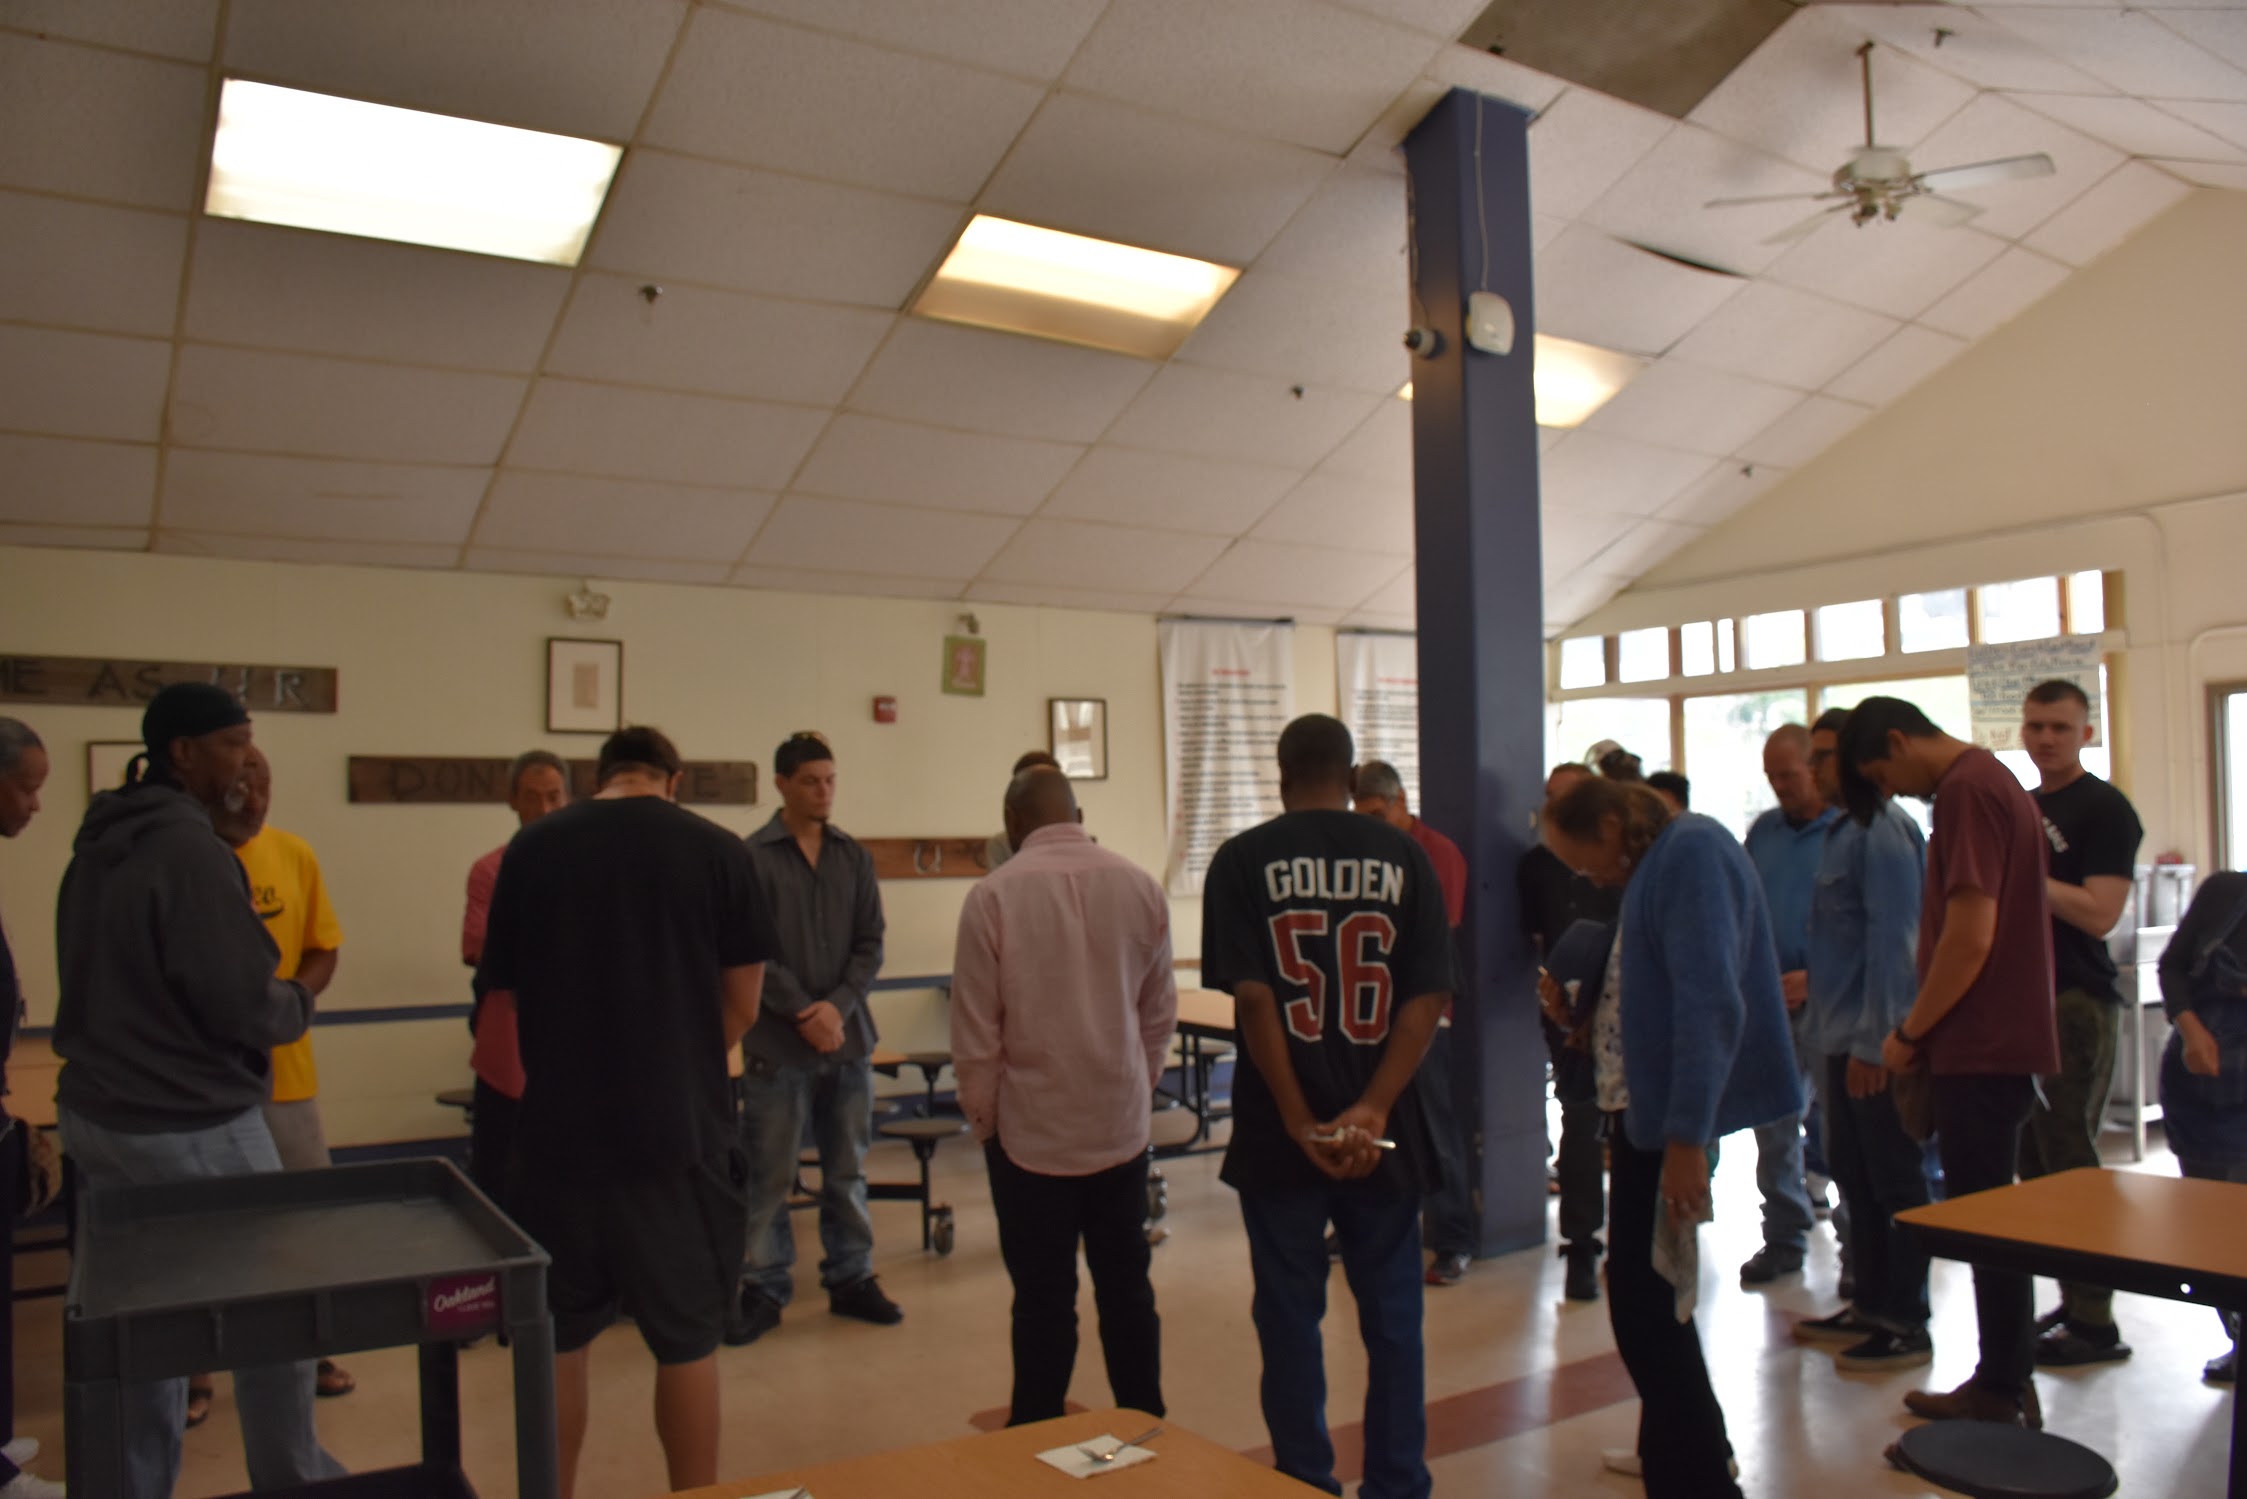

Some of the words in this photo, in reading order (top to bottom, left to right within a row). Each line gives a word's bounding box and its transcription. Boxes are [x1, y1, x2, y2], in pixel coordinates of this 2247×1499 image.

[87, 663, 163, 702] AS
[272, 668, 307, 708] R
[1264, 857, 1404, 906] GOLDEN
[1267, 909, 1397, 1045] 56
[433, 1275, 496, 1312] Oakland
